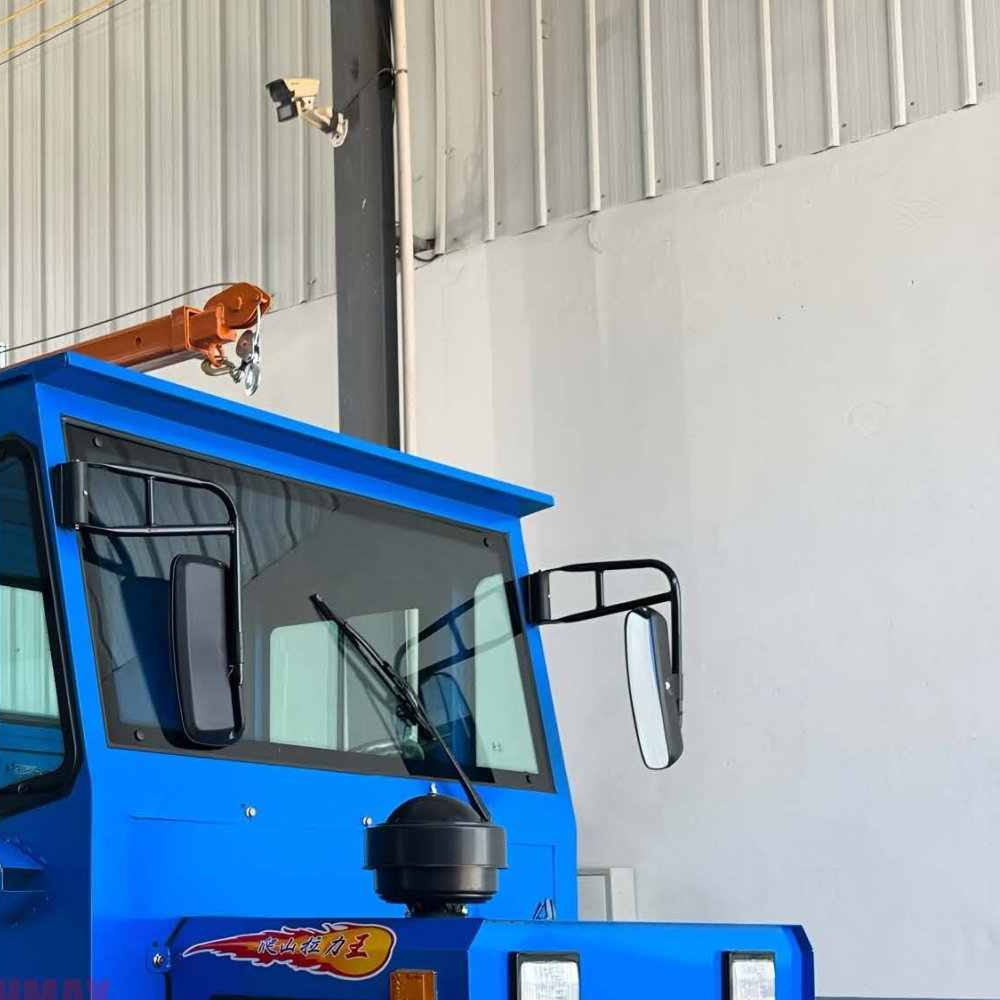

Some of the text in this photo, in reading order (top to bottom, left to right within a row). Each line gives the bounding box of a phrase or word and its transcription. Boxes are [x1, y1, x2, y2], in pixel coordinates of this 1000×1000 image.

[257, 933, 371, 960] 爬山拉力王
